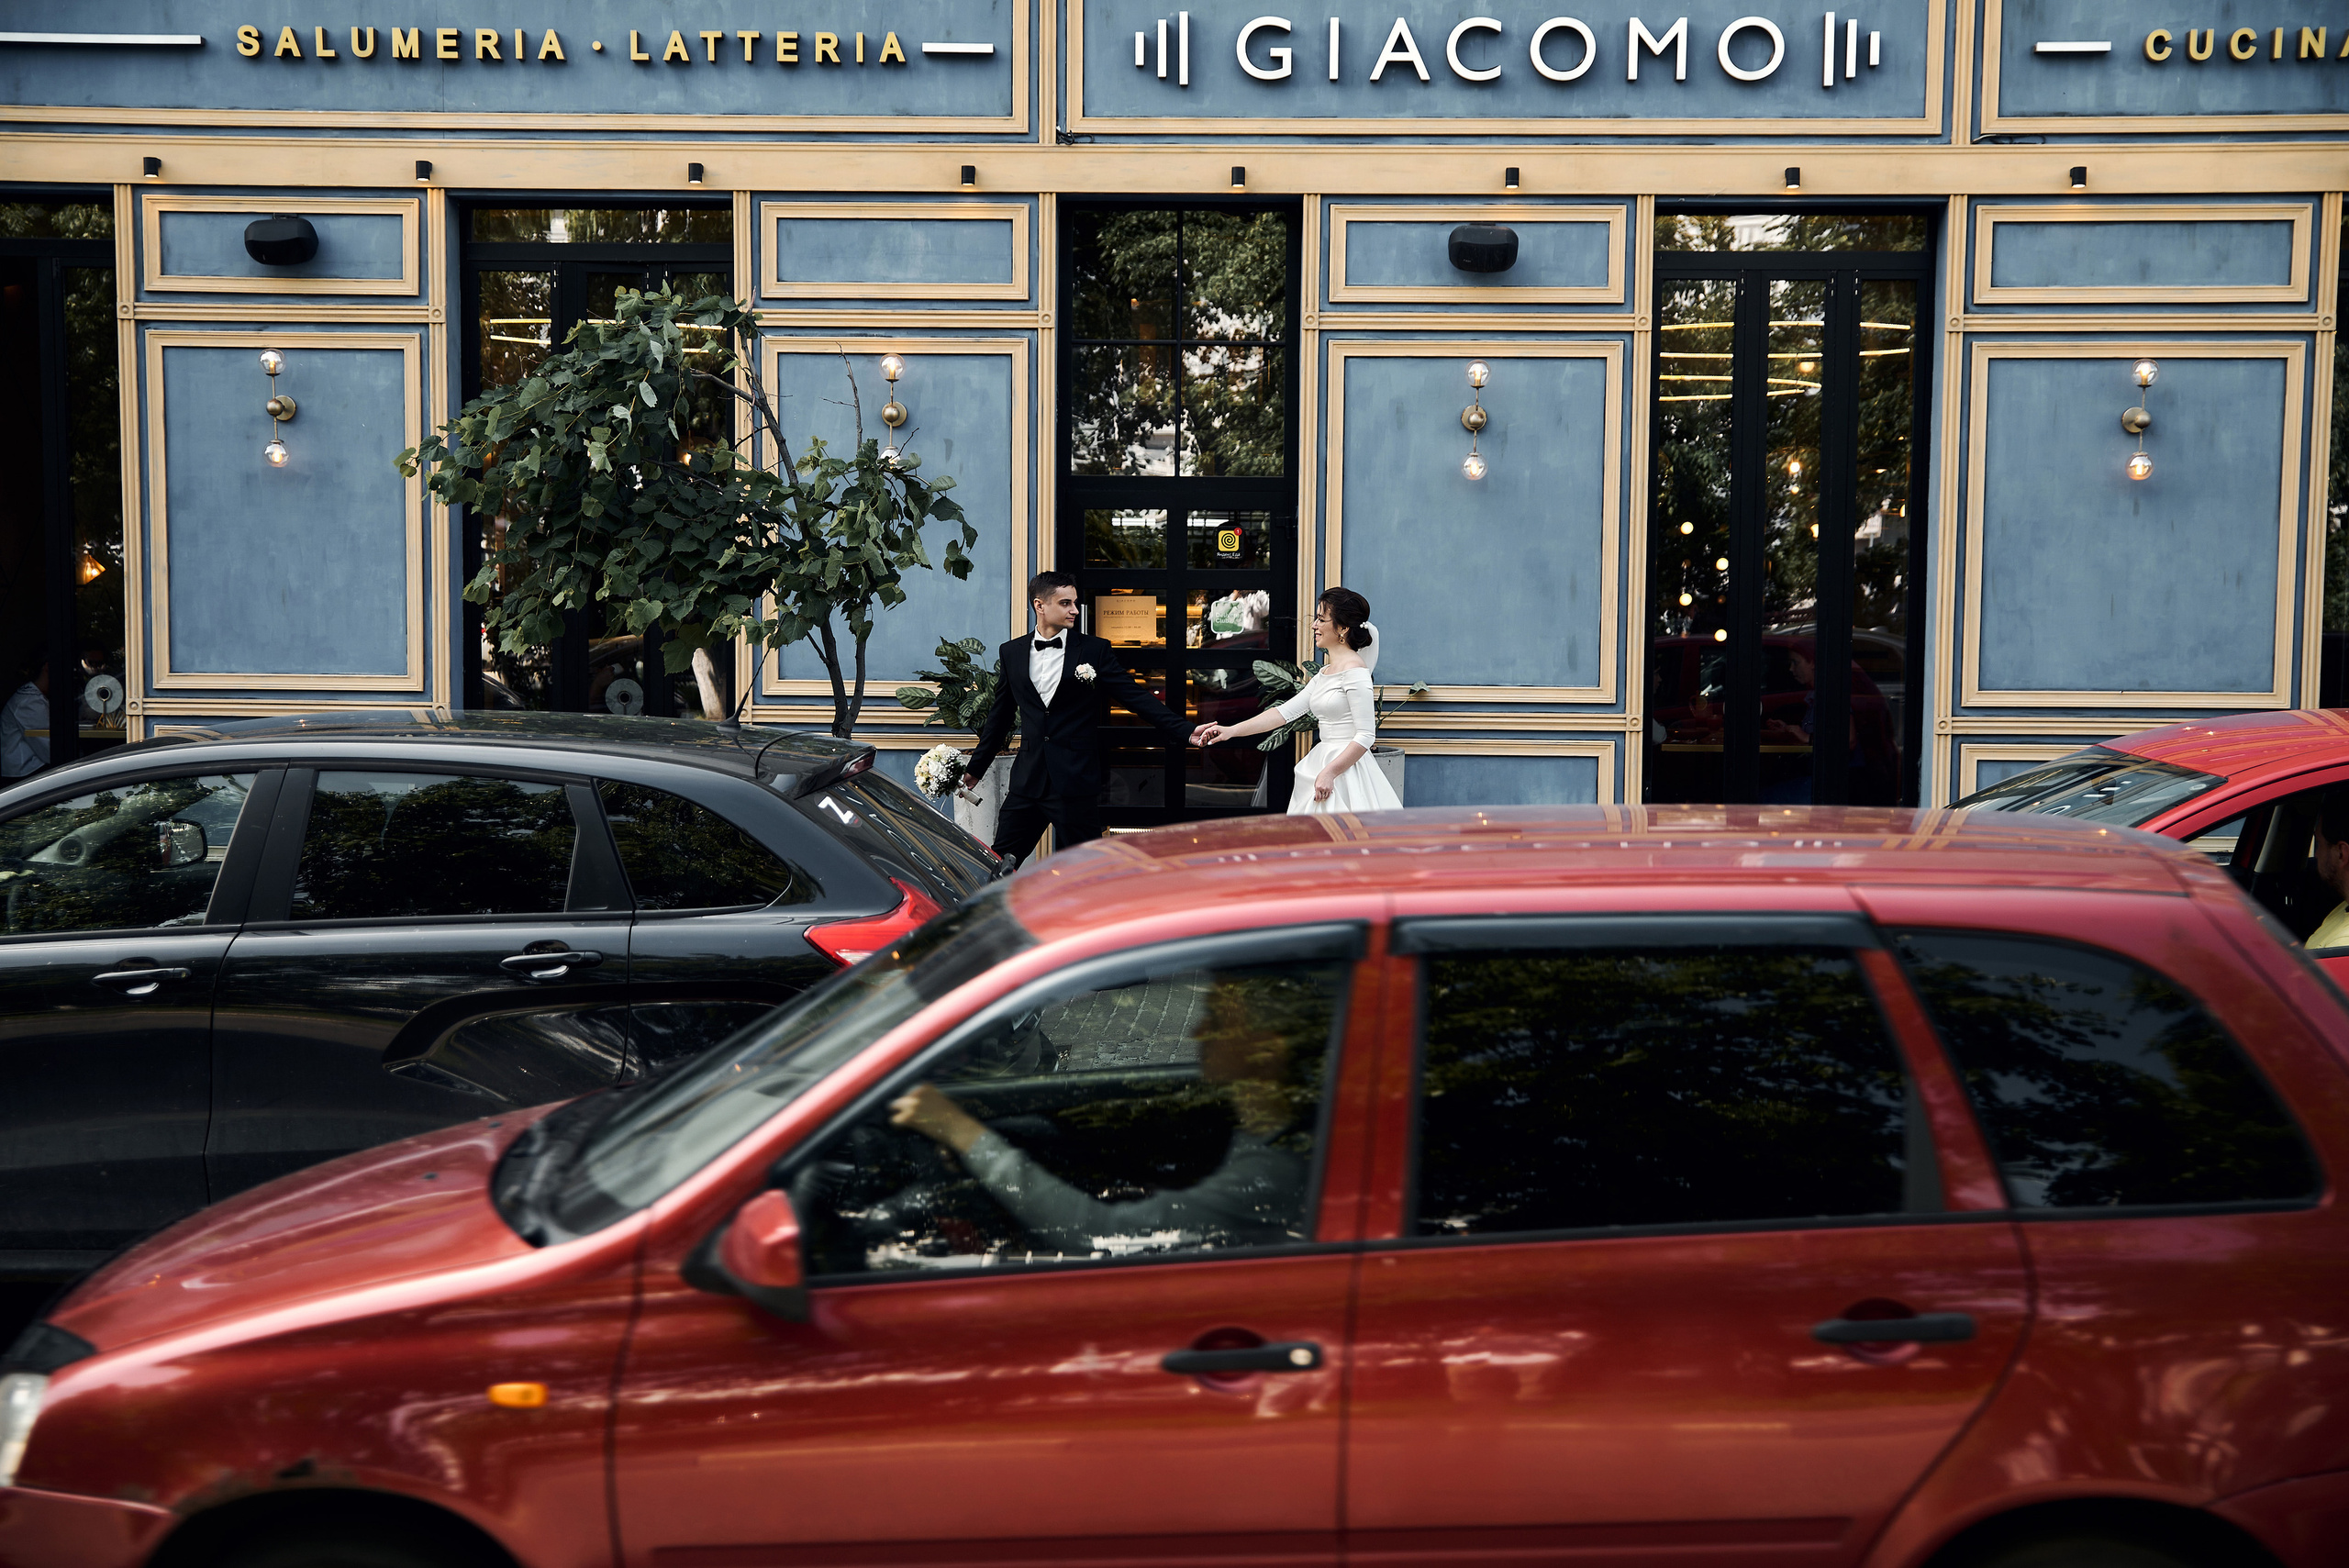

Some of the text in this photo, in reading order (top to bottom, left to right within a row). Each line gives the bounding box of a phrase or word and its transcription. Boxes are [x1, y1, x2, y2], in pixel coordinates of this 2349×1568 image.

[236, 25, 907, 63] SALUMERIA LATTERIA
[1235, 16, 1786, 81] GIACOMO
